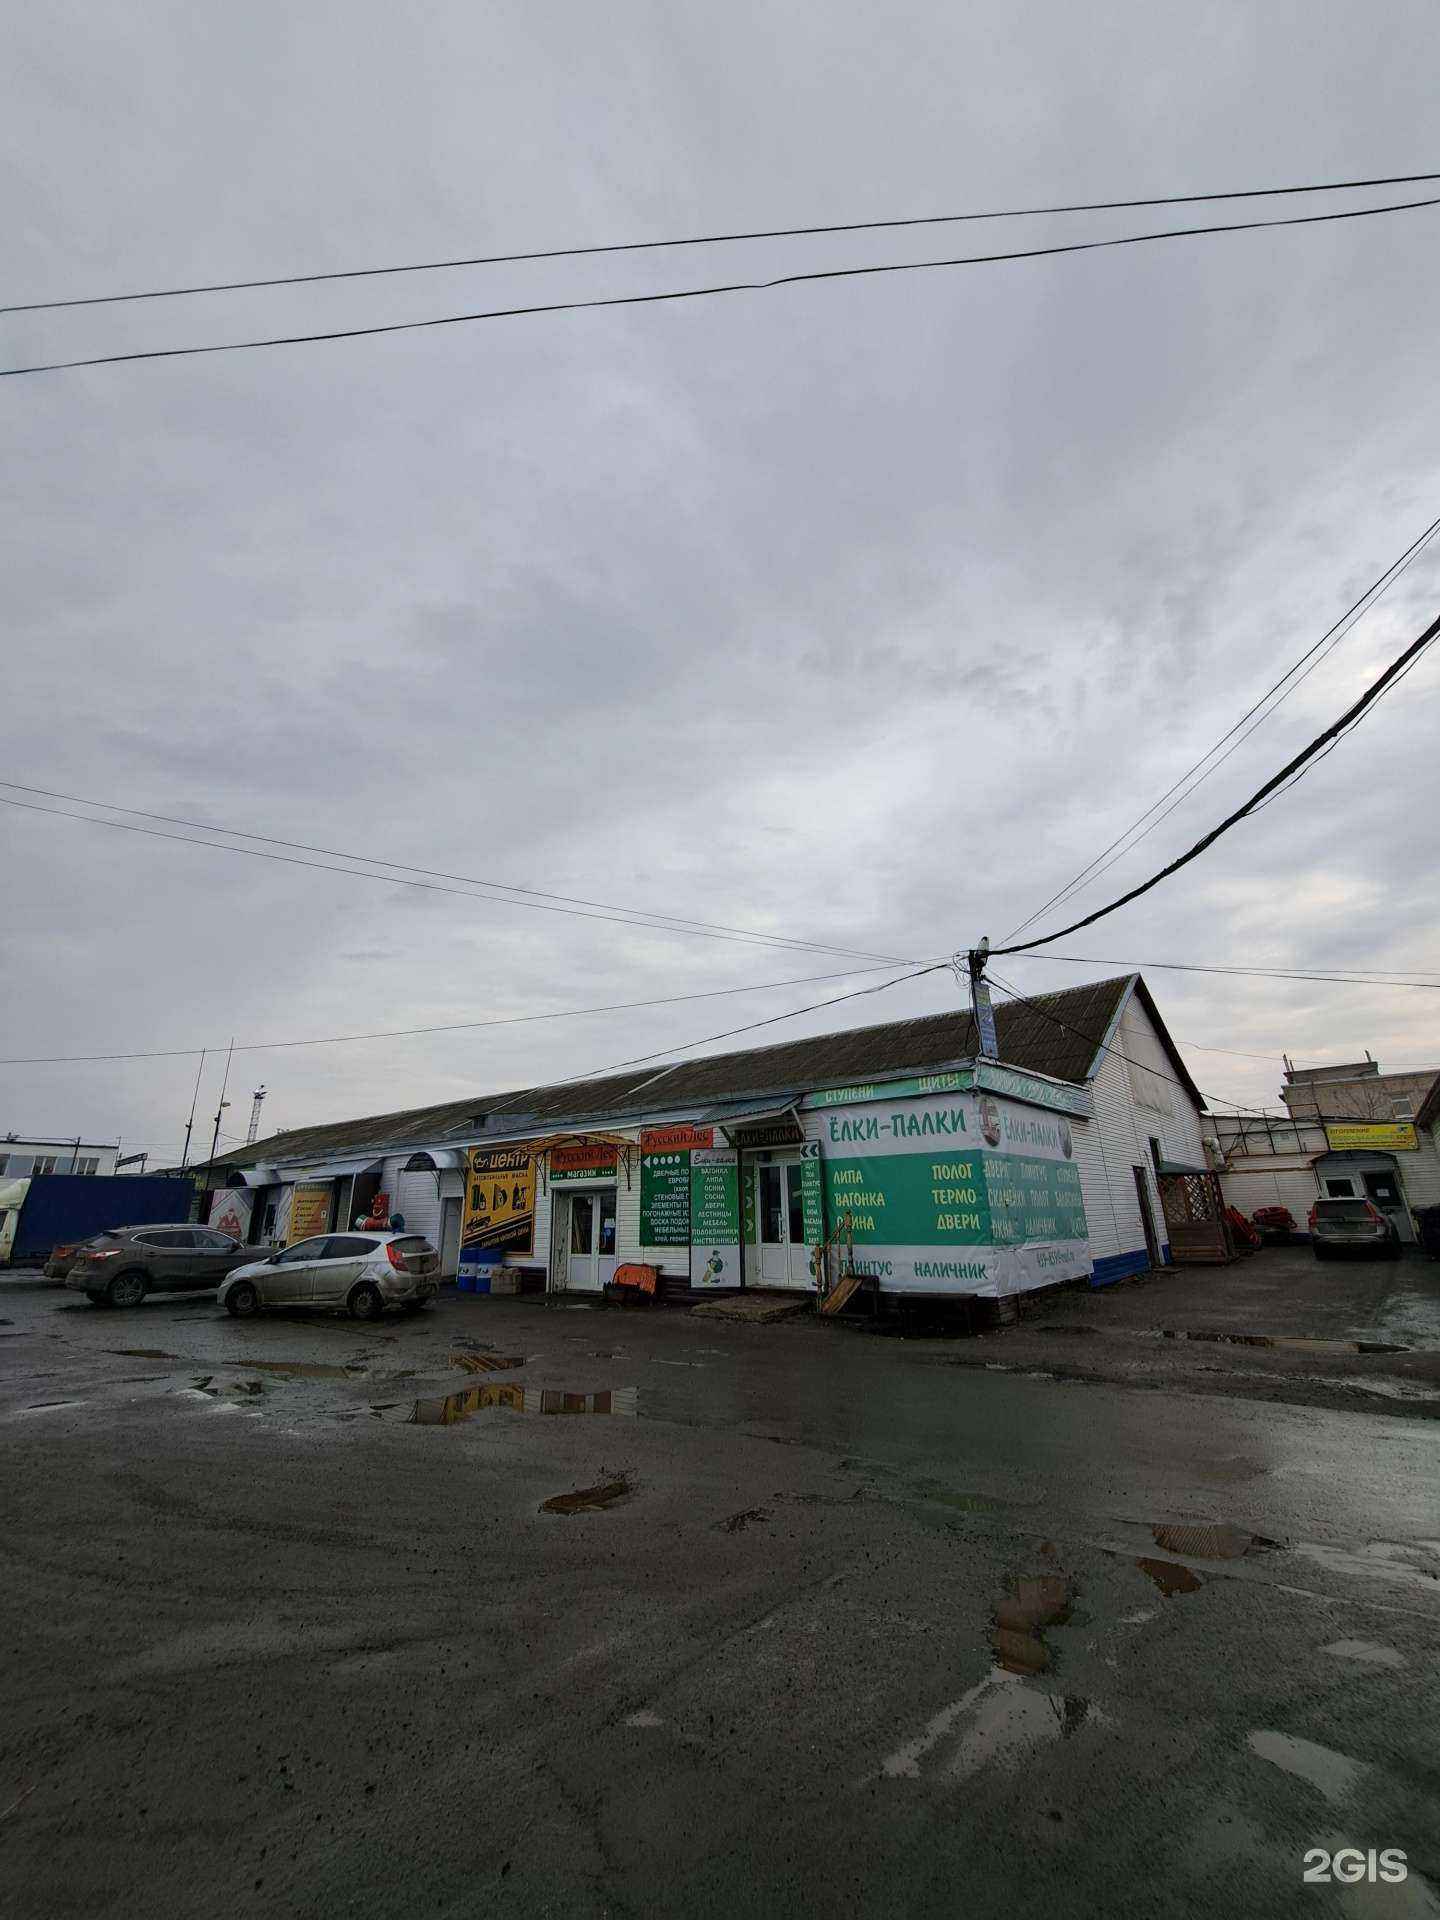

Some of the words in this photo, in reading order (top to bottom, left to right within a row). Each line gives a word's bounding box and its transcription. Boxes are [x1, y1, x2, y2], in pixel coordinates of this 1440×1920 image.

[918, 1072, 959, 1093] ЩИТЫ
[825, 1086, 874, 1102] СТУПЕНИ
[829, 1108, 967, 1142] ЁЛКИ-ПАЛКИ
[833, 1169, 863, 1185] ЛИПА
[834, 1191, 886, 1207] ВАГОНКА
[932, 1189, 977, 1205] ТЕРМО
[837, 1215, 876, 1230] ОИНА
[936, 1214, 981, 1230] ДВЕРИ
[913, 1261, 989, 1280] НАЛИЧНИК
